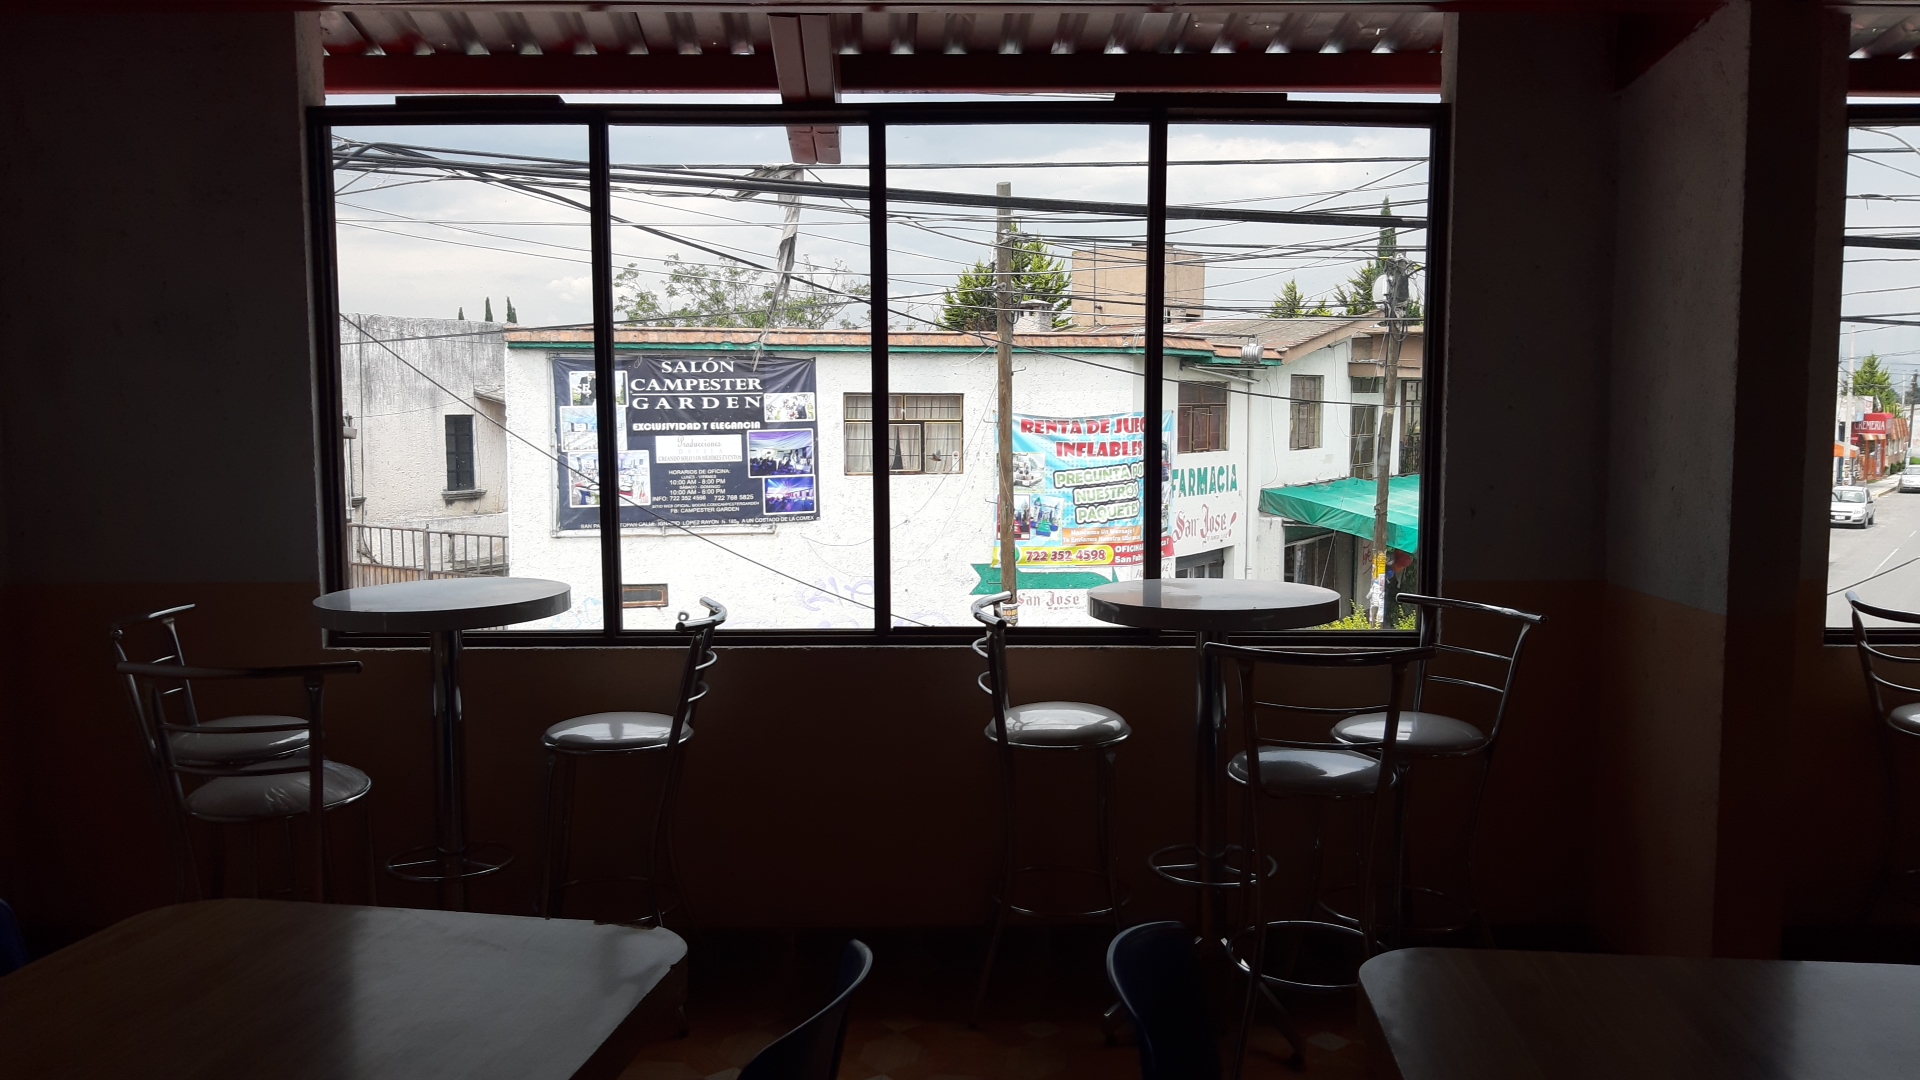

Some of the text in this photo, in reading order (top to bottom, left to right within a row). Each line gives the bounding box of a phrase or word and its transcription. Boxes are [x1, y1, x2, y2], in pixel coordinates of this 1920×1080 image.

[661, 358, 735, 373] SALÓN
[630, 378, 763, 392] CAMPESTER
[632, 396, 762, 410] GARDEN
[633, 421, 761, 431] EXCLUSIVIDAD Y ELEGANCIA
[1020, 418, 1083, 434] RENTA
[1086, 418, 1110, 434] DE
[1854, 420, 1886, 431] CREMERIA
[1056, 440, 1142, 457] INFLABLES
[1056, 462, 1144, 486] PREGUNTA PO
[1172, 464, 1238, 498] FARMACIA
[1076, 482, 1138, 503] NUESTROS
[1078, 502, 1138, 521] PAQUETES
[1172, 510, 1198, 544] San
[1026, 551, 1048, 562] 722
[1050, 550, 1073, 562] 352
[1075, 549, 1106, 562] 4598
[1017, 590, 1080, 607] San Jose
